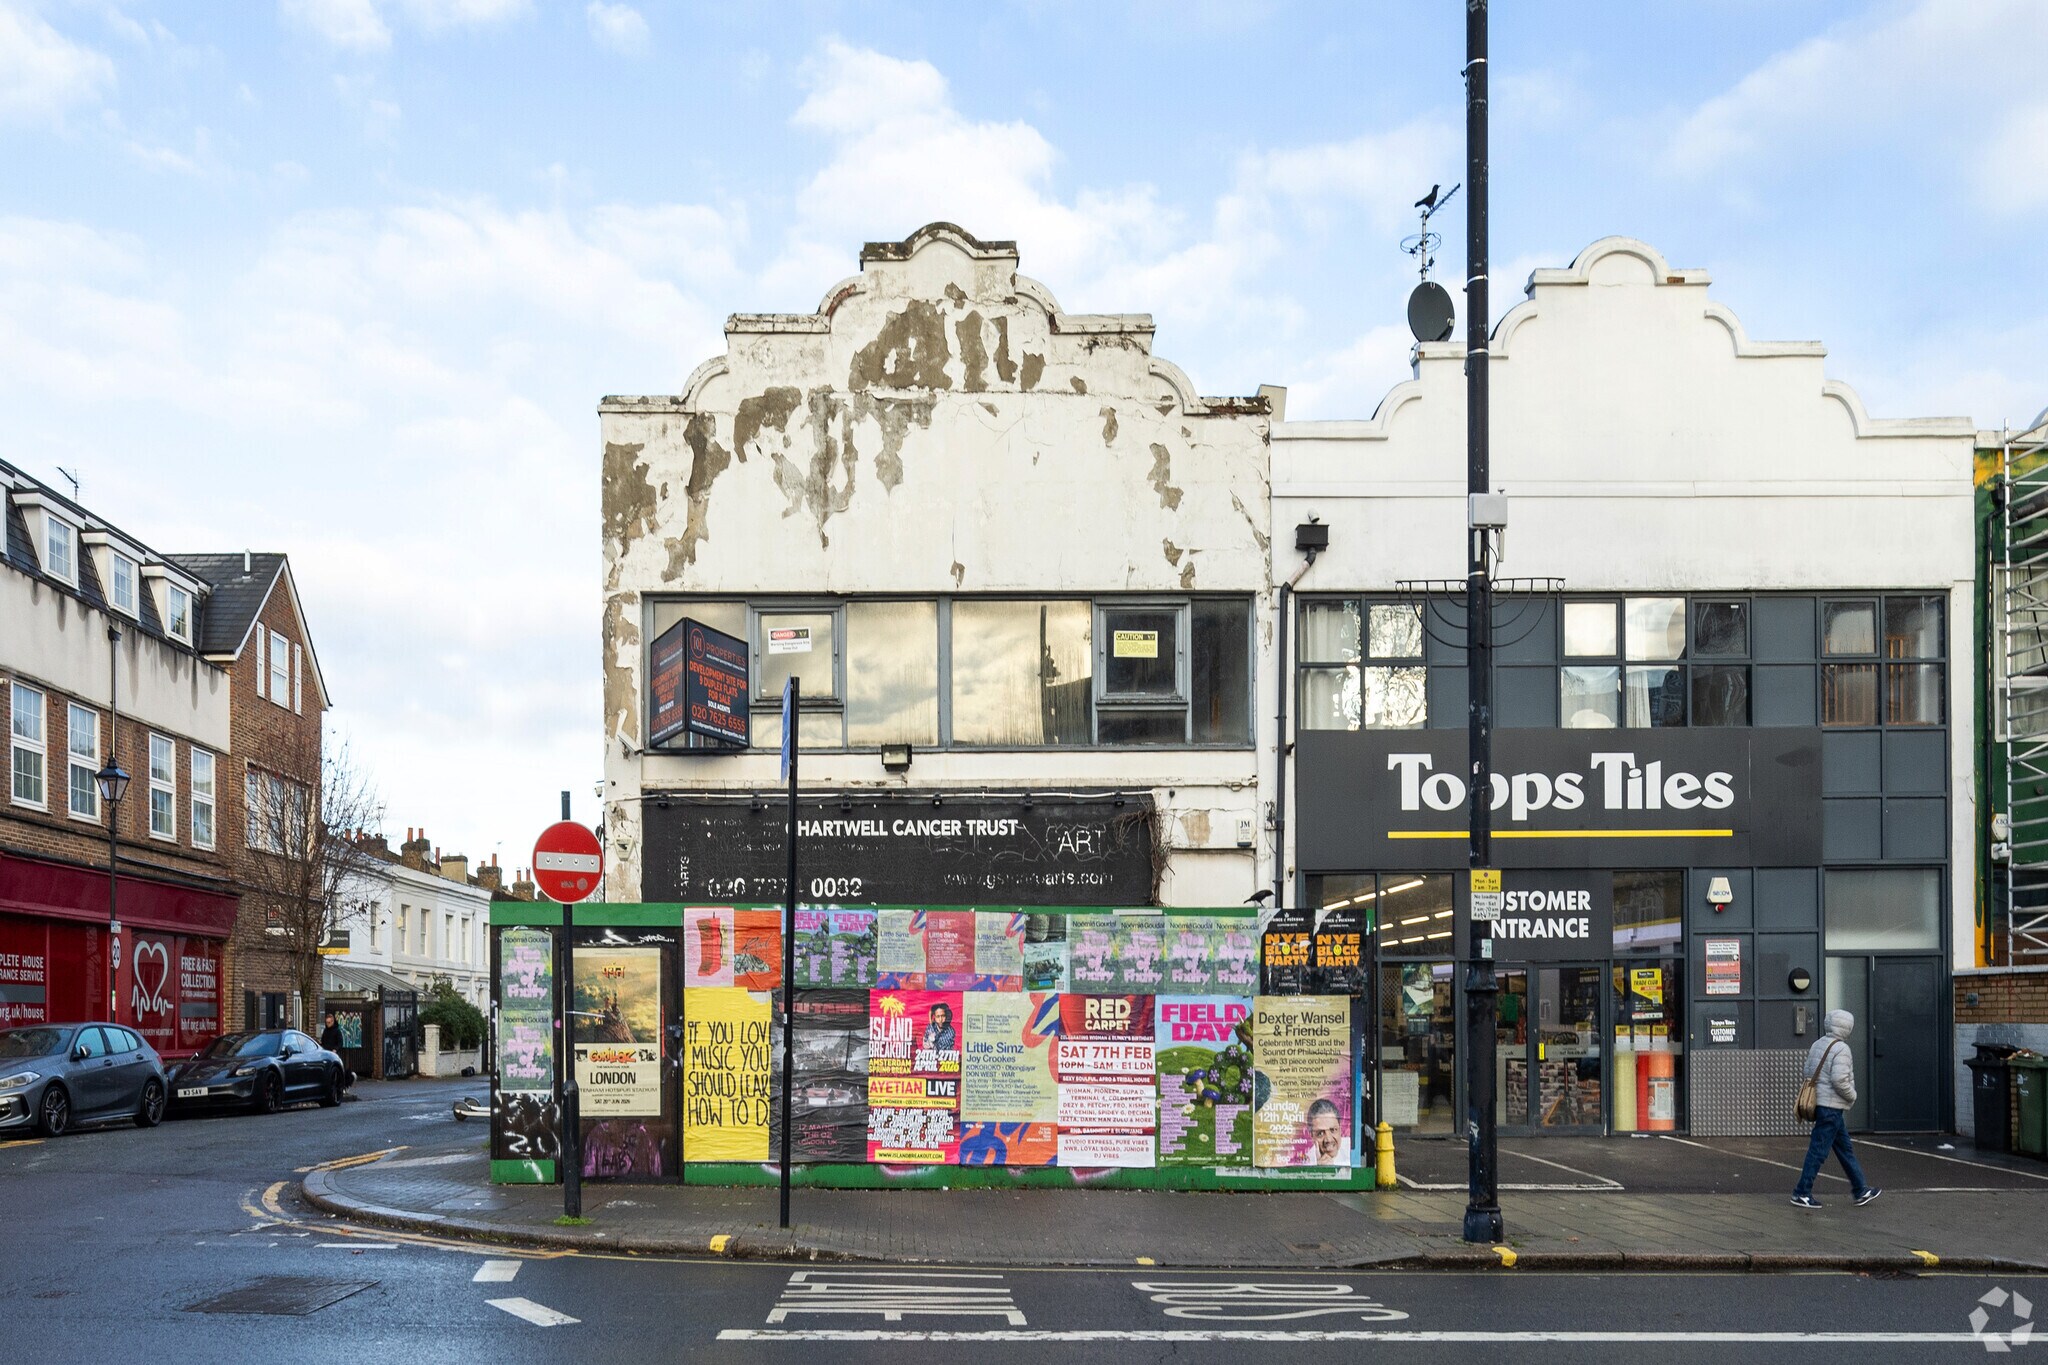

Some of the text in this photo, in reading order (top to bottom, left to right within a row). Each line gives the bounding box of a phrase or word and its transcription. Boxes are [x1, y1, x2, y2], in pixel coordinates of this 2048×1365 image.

[706, 642, 746, 666] PROPERTIES
[690, 660, 725, 682] DEVELOPMENT
[726, 675, 736, 687] SITE
[737, 679, 747, 691] FOR
[704, 679, 738, 698] DUPLEX FLATS
[708, 690, 731, 705] FOR SALE
[692, 704, 707, 720] 020
[709, 710, 727, 727] 7625
[728, 716, 746, 733] 6555
[1590, 752, 1735, 810] Tiles
[785, 819, 1019, 836] HARTWELL CANCER TRUST
[834, 913, 874, 922] FIELD
[838, 922, 868, 932] DAY
[1491, 918, 1589, 939] NTRANCE
[1265, 933, 1309, 945] NYE
[1316, 934, 1360, 945] NYE
[22, 955, 44, 969] HOUSE
[181, 956, 195, 971] FREE
[202, 958, 216, 973] FAST
[1265, 955, 1309, 967] PARTY
[1317, 956, 1360, 967] PARTY
[20, 969, 44, 982] SERVICE
[181, 973, 216, 989] COLLECTION
[1085, 998, 1131, 1019] RED
[1161, 1004, 1246, 1023] FIELD
[1258, 1011, 1345, 1024] Dexter Wansel
[869, 1016, 913, 1042] ISLAND
[1085, 1020, 1130, 1031] CARPET
[1273, 1025, 1330, 1036] & Friends
[1710, 1028, 1736, 1036] CUSTOMER
[688, 1021, 702, 1045] IF
[707, 1021, 734, 1046] YOU
[1171, 1023, 1235, 1042] DAY
[966, 1042, 1024, 1053] Little Simz
[1258, 1039, 1293, 1047] Celebrate
[1294, 1039, 1316, 1047] MFSB
[868, 1041, 912, 1059] BREAKOUT
[1060, 1046, 1152, 1059] SAT 7TH FEB
[1262, 1048, 1342, 1057] Sound Of Philadelphia
[692, 1045, 770, 1072] MUSIC YOU
[869, 1059, 912, 1067] AMSTERDAM
[966, 1055, 1016, 1063] Joy Crookes
[1289, 1058, 1307, 1066] piece
[913, 1060, 960, 1072] APRIL 2026
[1093, 1062, 1114, 1070] 5AM
[1134, 1062, 1153, 1070] LDN
[590, 1071, 636, 1085] LONDON
[687, 1071, 771, 1099] SHOULD LEAR
[869, 1080, 955, 1096] AYETIAN LIVE
[687, 1098, 722, 1127] HOW
[728, 1098, 749, 1126] TO
[1262, 1101, 1300, 1112] Sunday
[1259, 1112, 1305, 1124] 12th April
[1269, 1124, 1293, 1135] 2026
